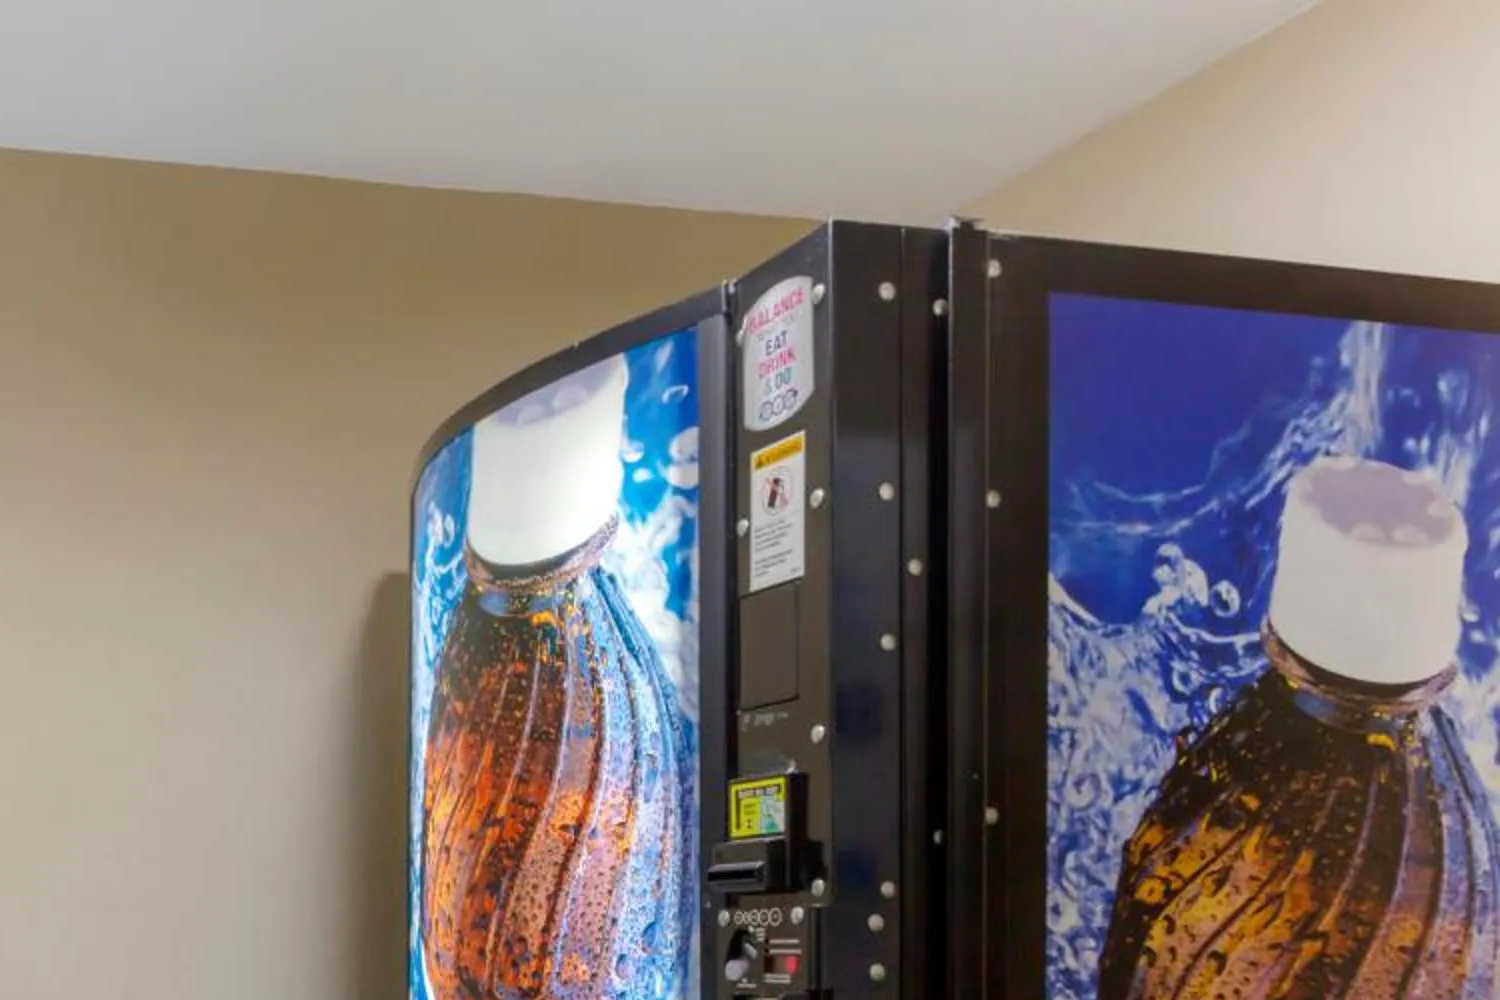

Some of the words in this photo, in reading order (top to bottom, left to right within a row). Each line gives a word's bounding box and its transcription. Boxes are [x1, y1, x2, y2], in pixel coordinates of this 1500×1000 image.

[746, 288, 805, 333] BALANCE
[765, 330, 788, 356] EAT
[758, 347, 797, 379] DRINK
[775, 367, 793, 390] DO
